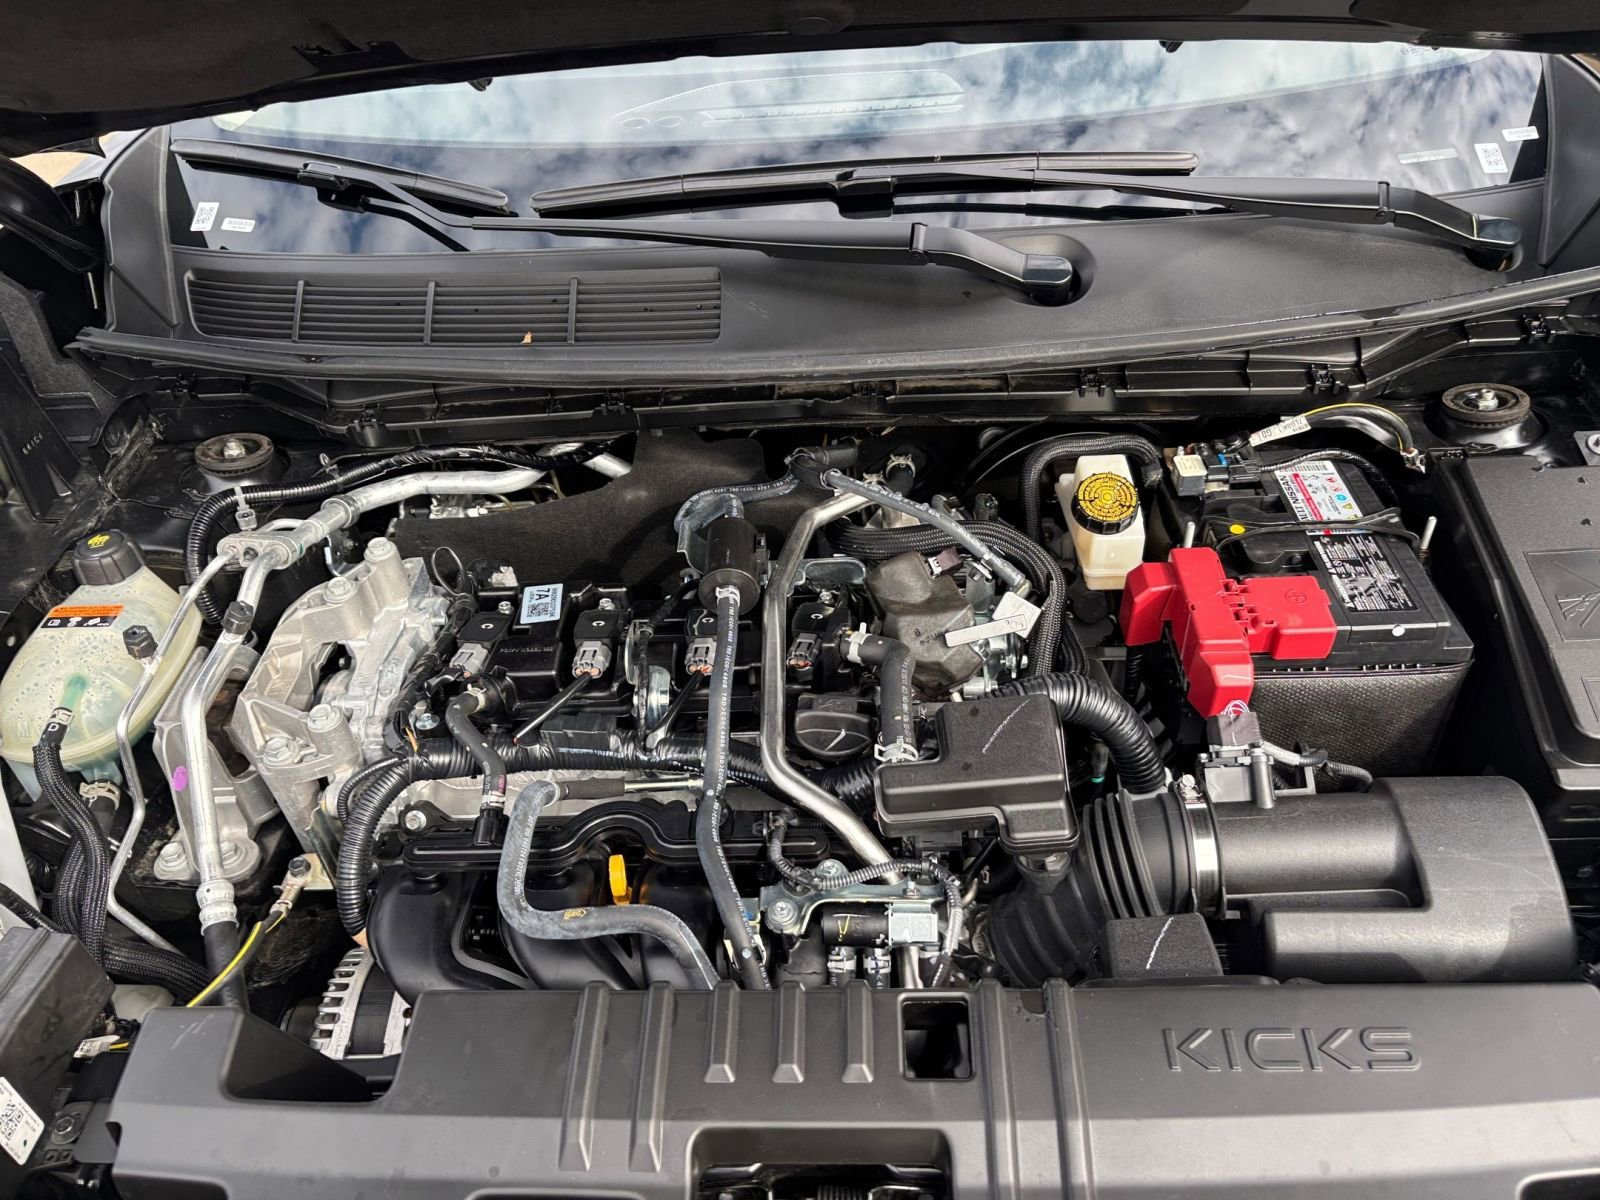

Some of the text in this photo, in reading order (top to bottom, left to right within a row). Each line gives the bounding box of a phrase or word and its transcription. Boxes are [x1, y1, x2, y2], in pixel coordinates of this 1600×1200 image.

[1280, 475, 1299, 504] NISSAN
[535, 588, 551, 601] 7A
[48, 723, 59, 732] D
[1162, 1027, 1422, 1072] KICKS
